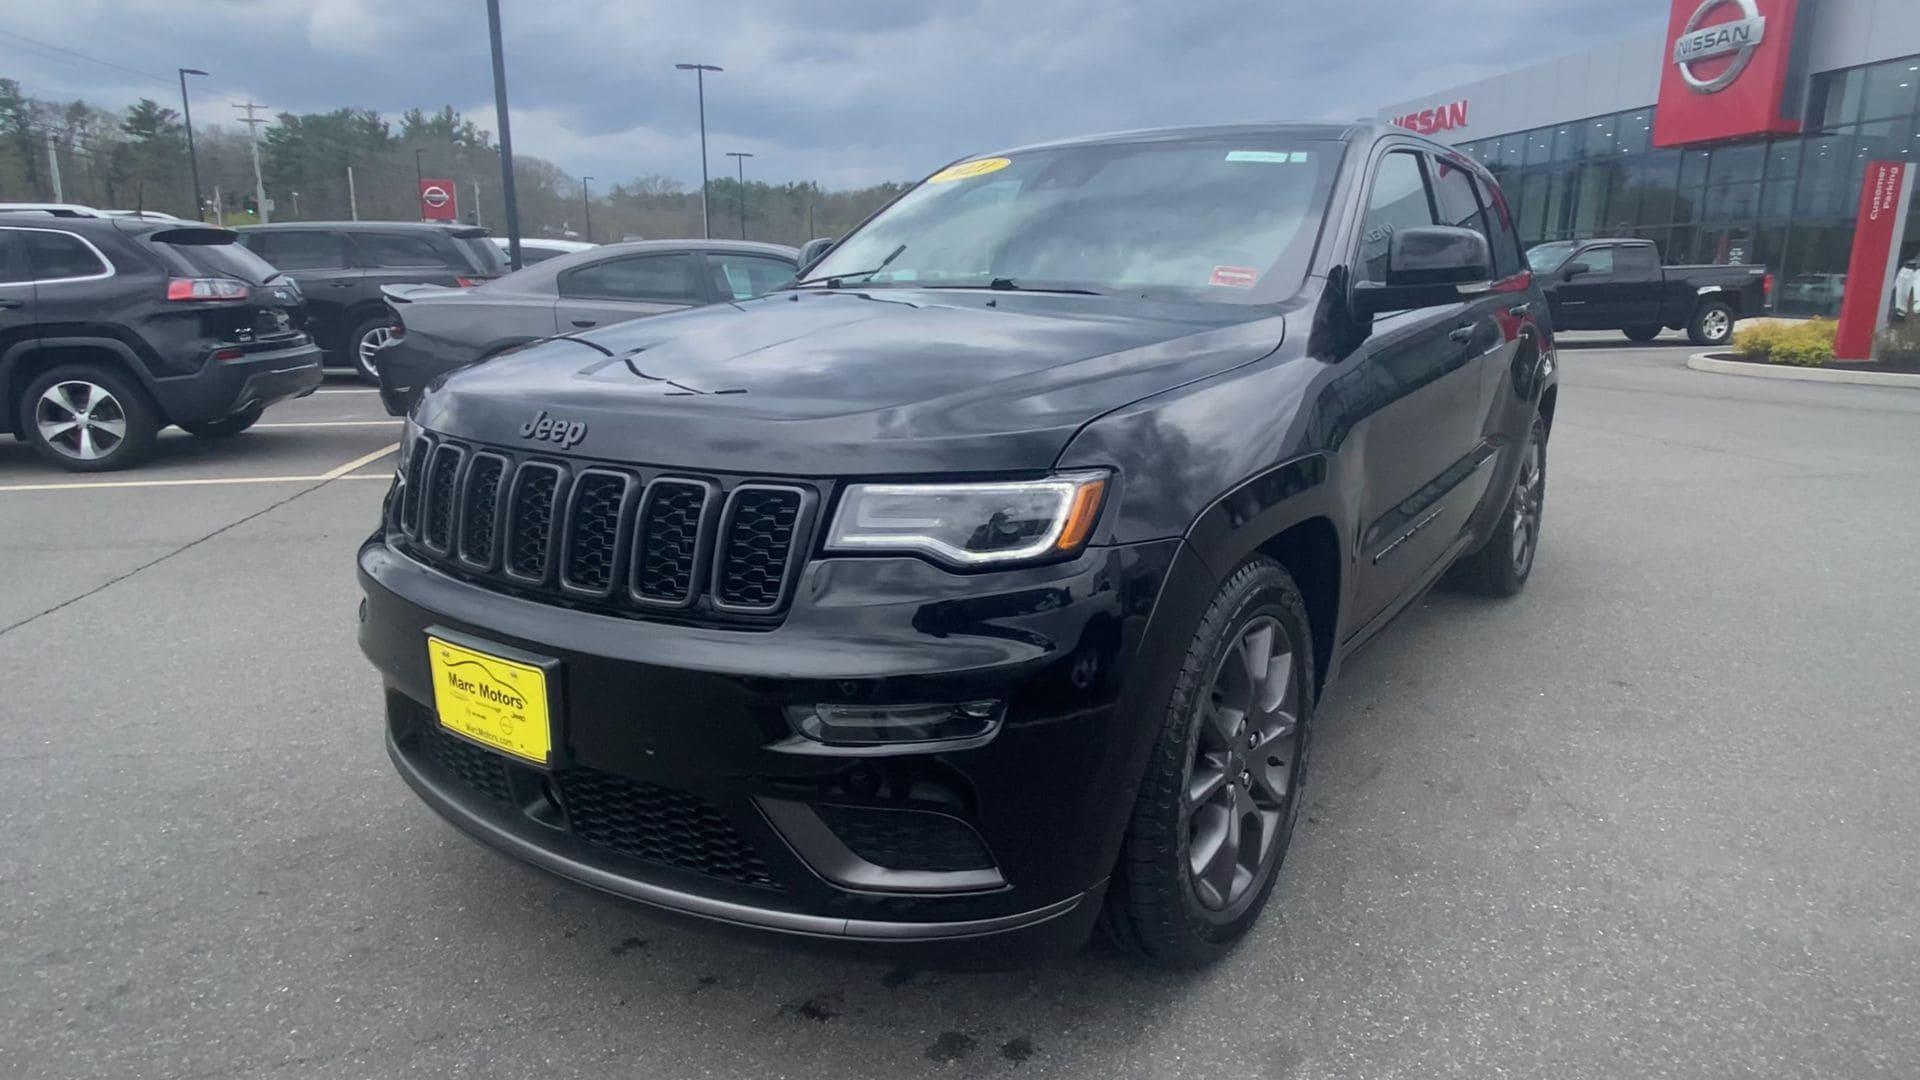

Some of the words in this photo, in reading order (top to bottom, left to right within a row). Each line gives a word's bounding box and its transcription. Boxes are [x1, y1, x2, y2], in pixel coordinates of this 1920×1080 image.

[1680, 25, 1750, 54] NISSAN
[1870, 166, 1886, 220] Customer
[1882, 167, 1898, 209] Parking
[520, 410, 587, 450] Jeep
[448, 672, 476, 694] Marc
[479, 683, 524, 710] Motors
